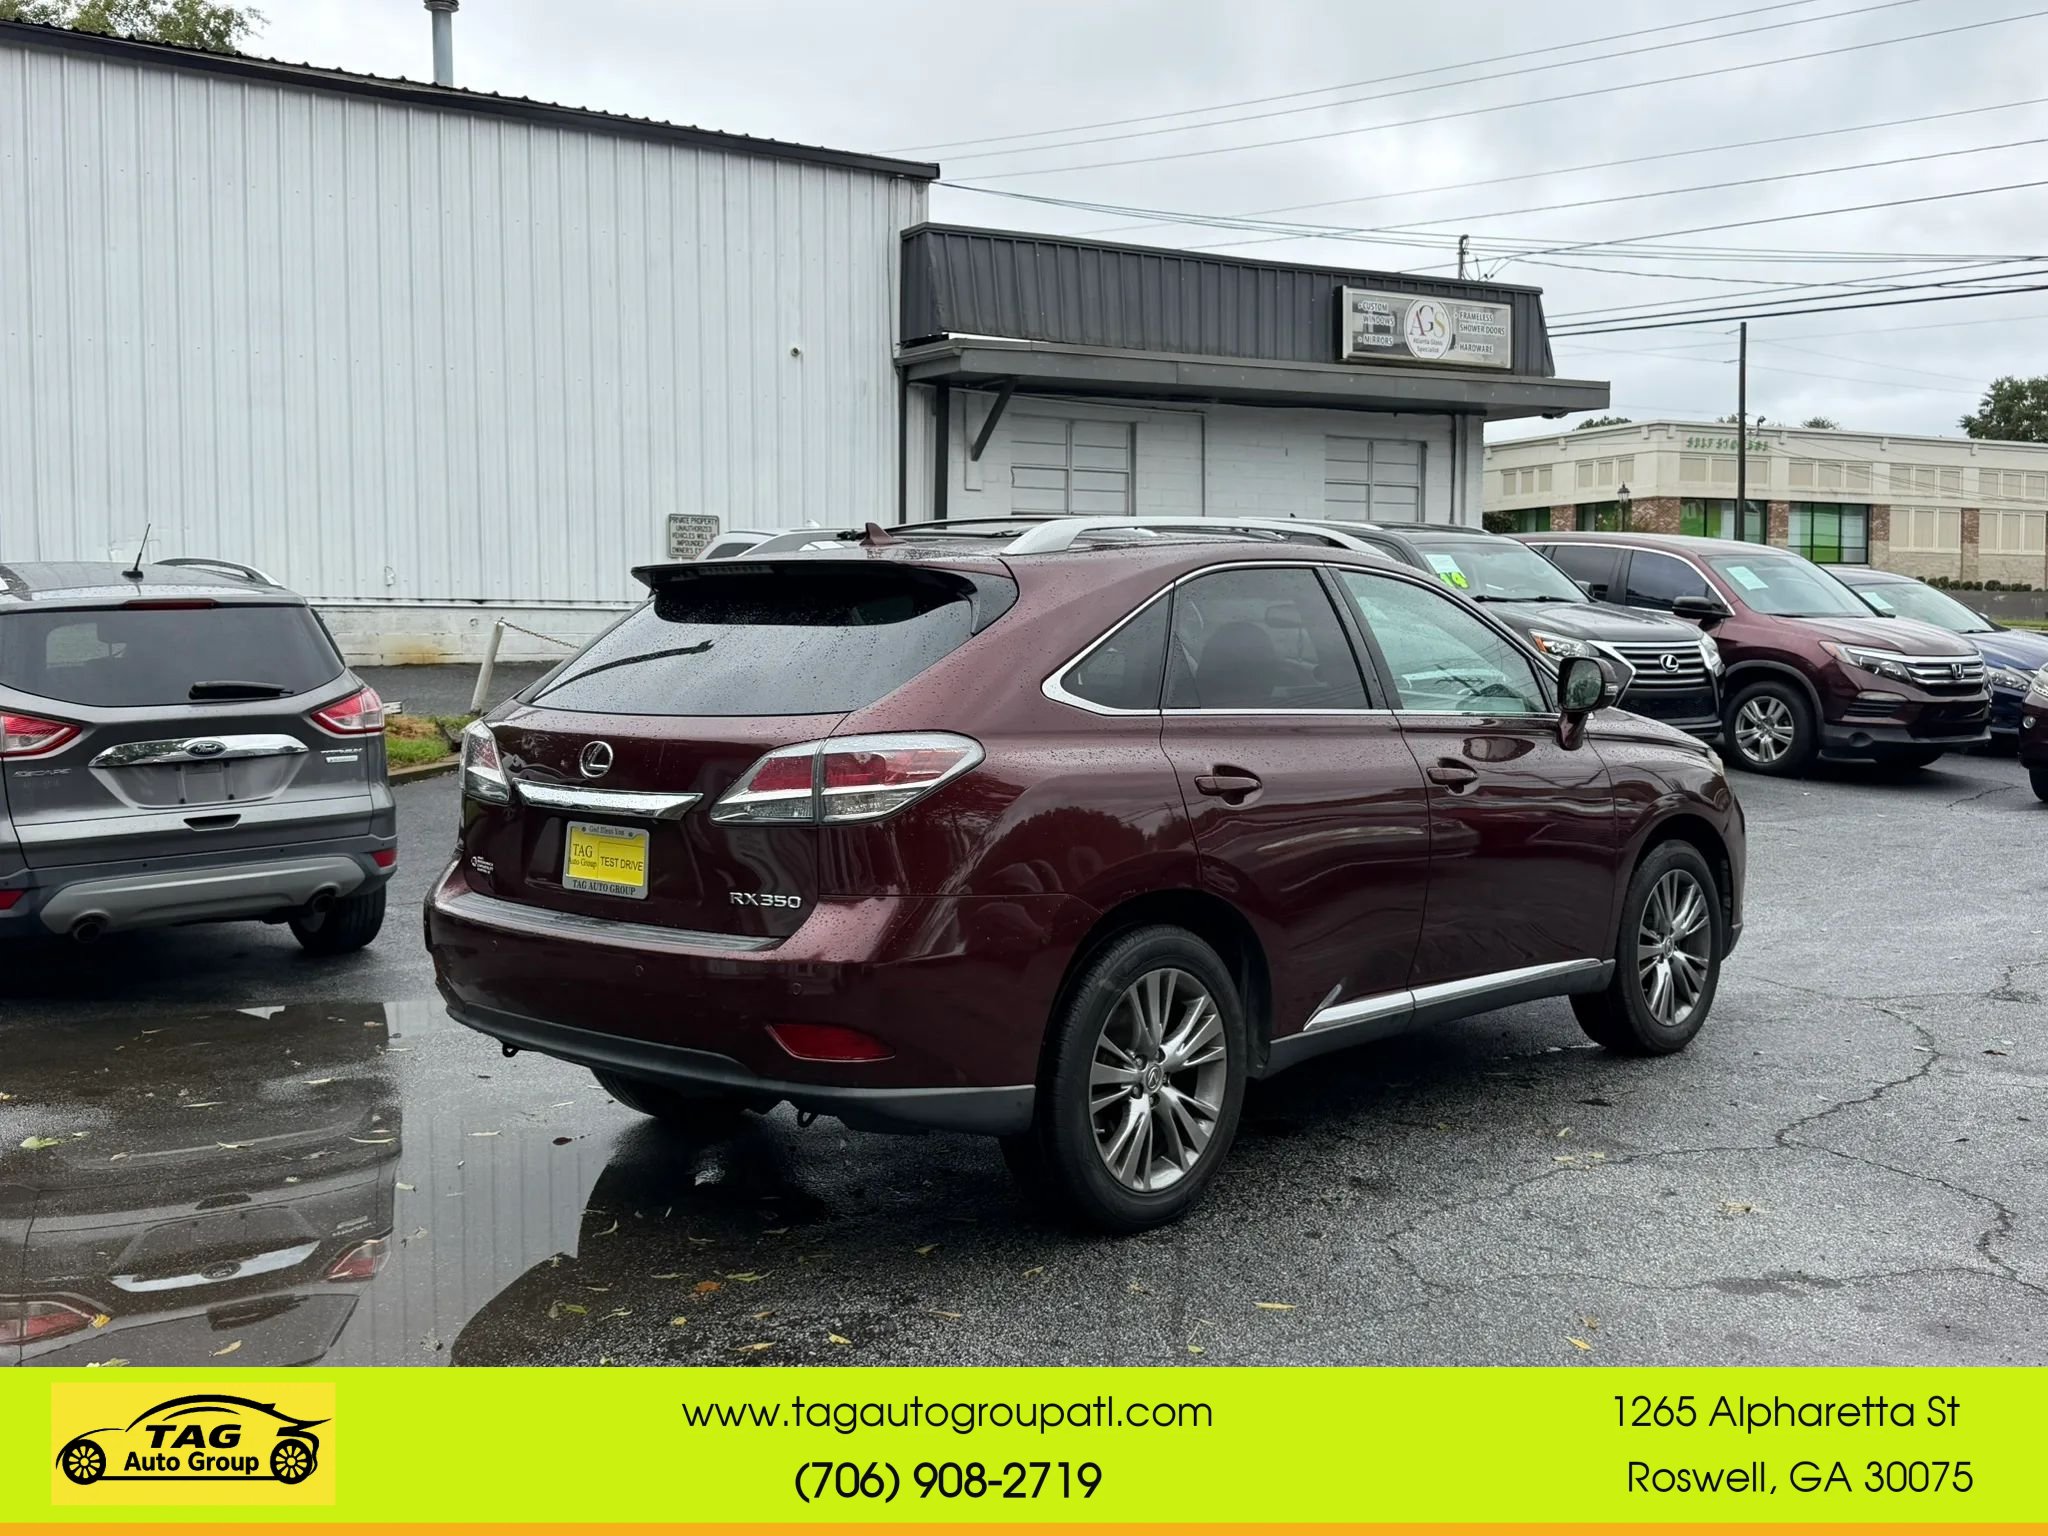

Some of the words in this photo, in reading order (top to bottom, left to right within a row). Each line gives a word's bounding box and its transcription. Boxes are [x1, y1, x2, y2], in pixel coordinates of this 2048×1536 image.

[1362, 302, 1388, 311] CUSTOM
[1363, 315, 1394, 326] WINDOWS
[1409, 305, 1446, 338] AGS
[1460, 312, 1493, 321] FRAMELESS
[1460, 324, 1485, 333] SHOWER
[1485, 326, 1504, 335] DOORS
[1363, 335, 1393, 346] MIRRORS
[1459, 344, 1493, 353] HARDWARE
[1716, 438, 1768, 451] STOAGE
[572, 843, 593, 858] TAG
[580, 859, 597, 870] Group
[600, 856, 619, 868] TEST
[620, 859, 644, 872] DRIVE
[572, 879, 587, 889] TAG
[587, 881, 609, 892] AUTO
[610, 884, 636, 896] GROUP
